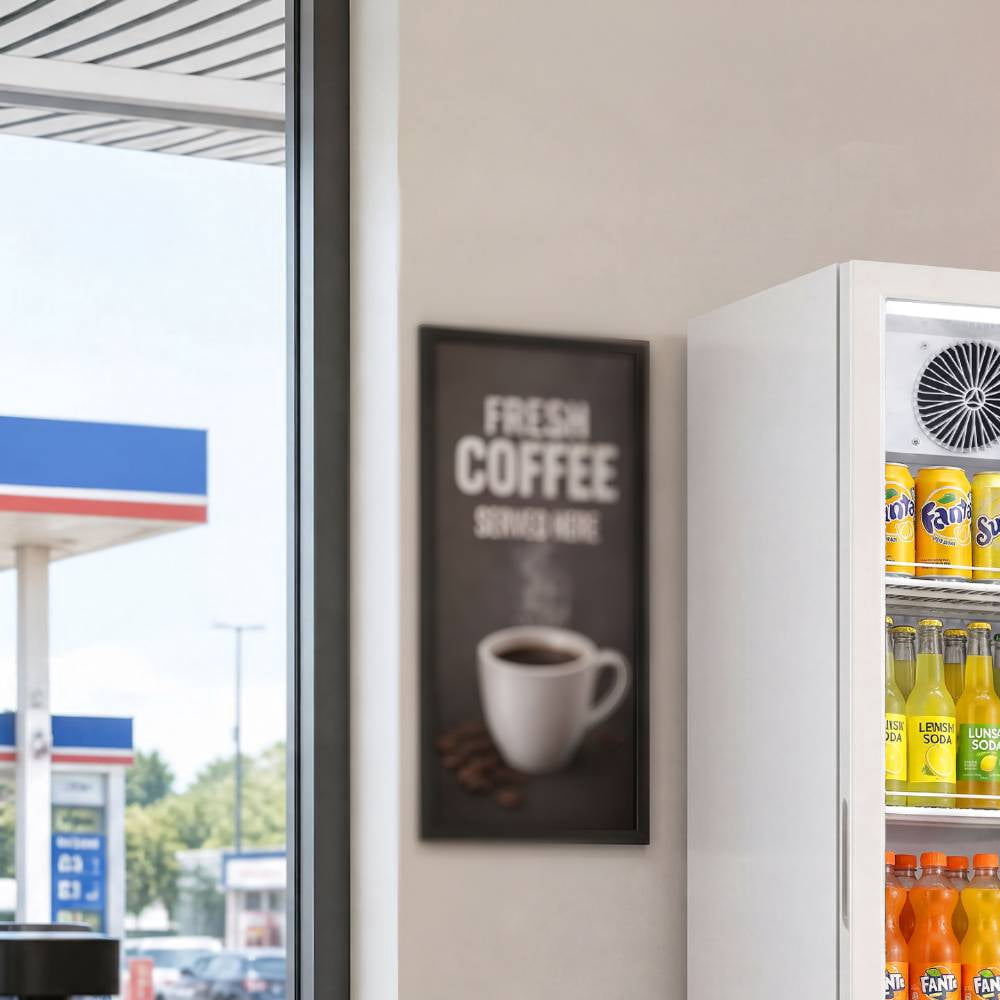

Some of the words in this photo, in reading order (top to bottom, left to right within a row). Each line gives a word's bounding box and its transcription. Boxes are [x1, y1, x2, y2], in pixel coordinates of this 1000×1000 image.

[483, 394, 591, 439] FRESH
[454, 434, 621, 503] COFFEE
[923, 733, 952, 745] SODA
